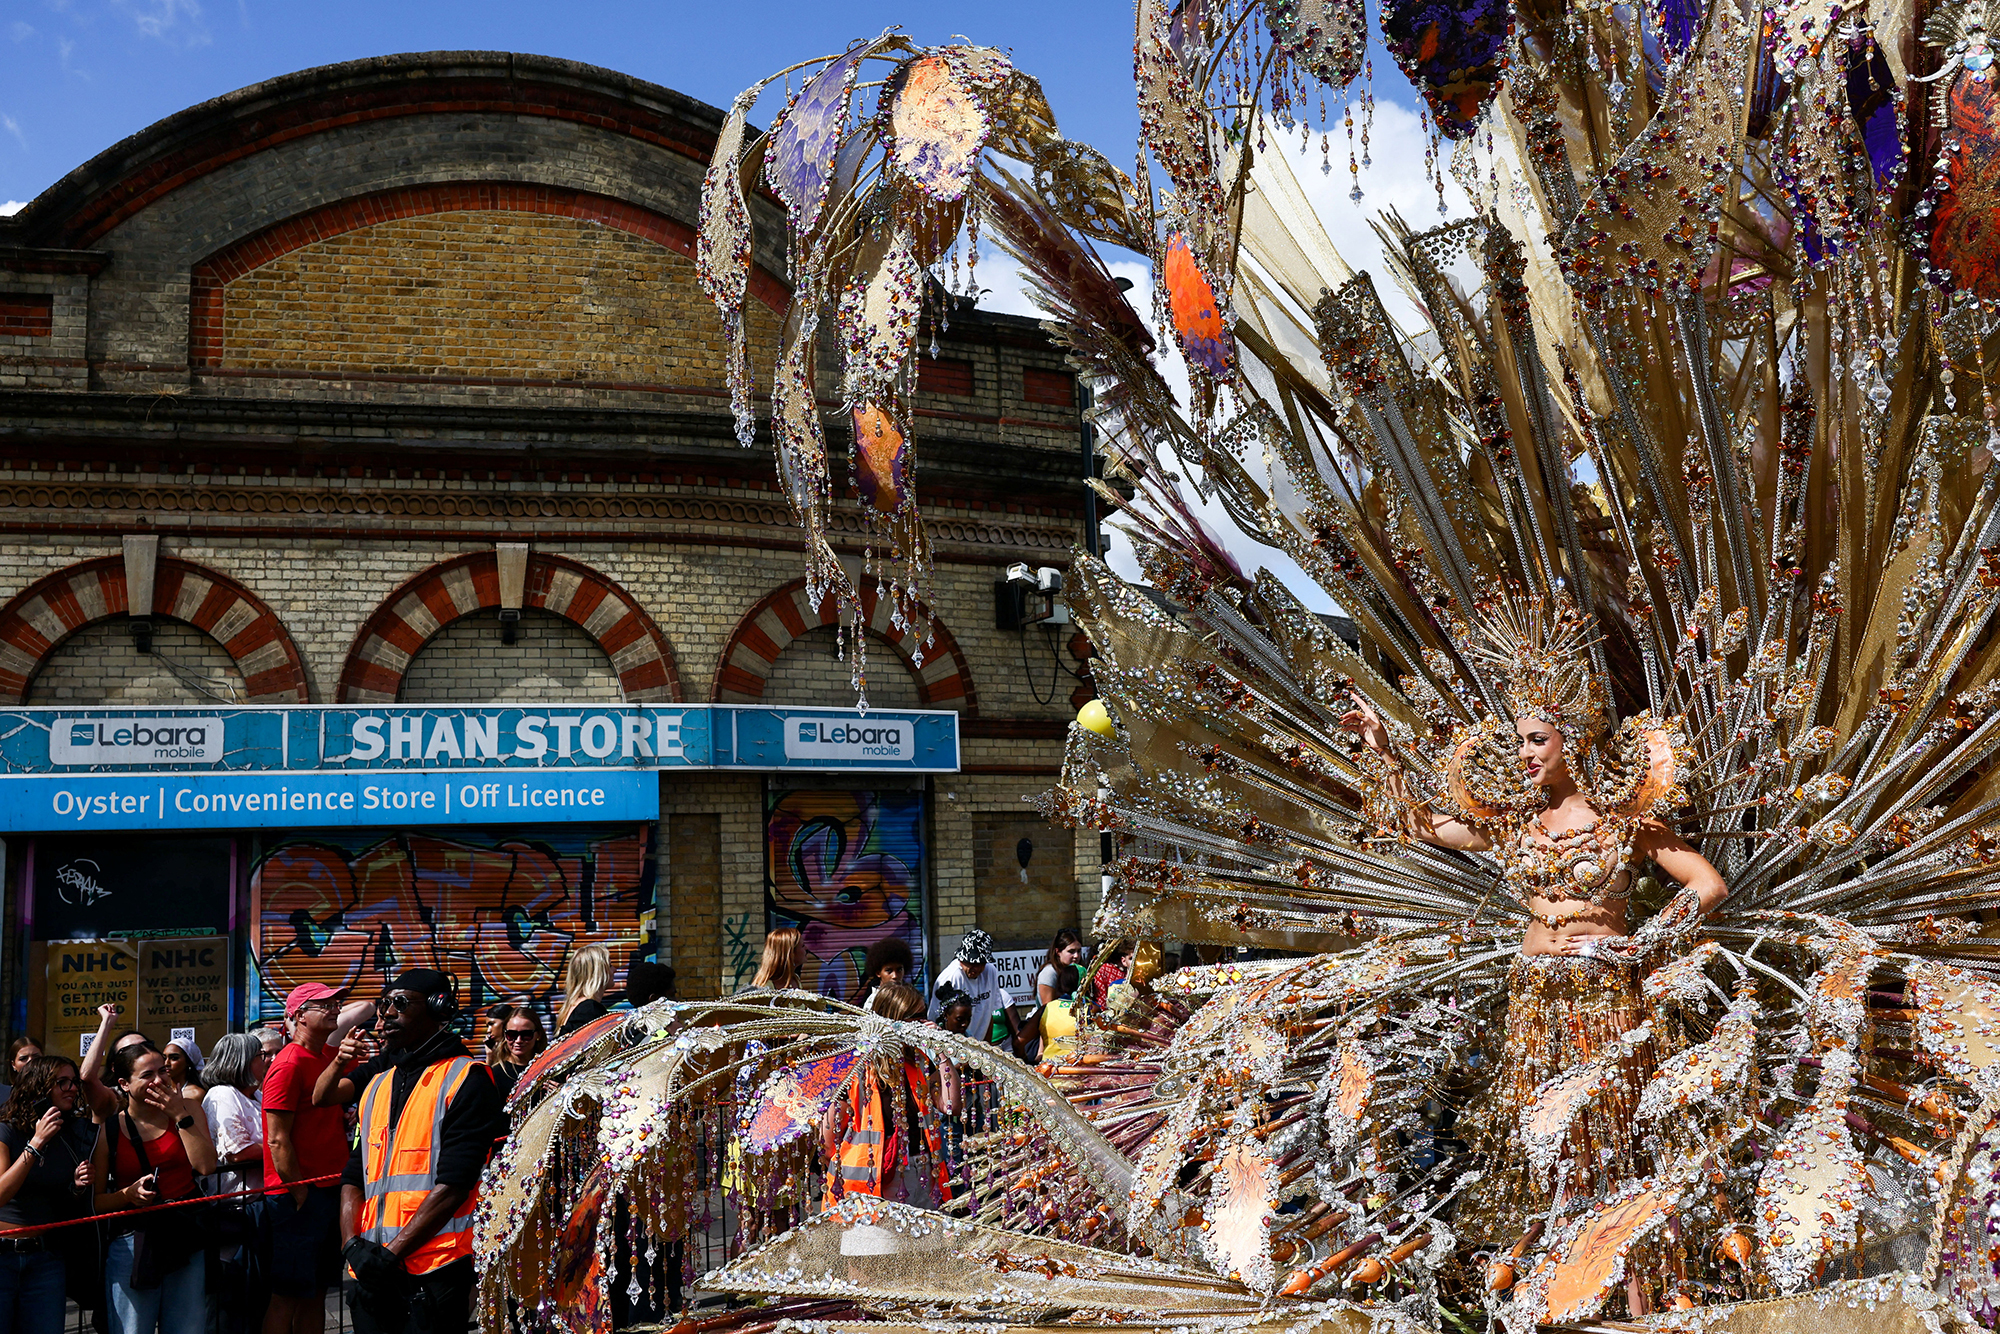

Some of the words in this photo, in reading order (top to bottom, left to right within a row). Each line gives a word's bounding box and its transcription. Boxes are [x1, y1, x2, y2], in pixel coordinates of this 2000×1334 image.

[98, 723, 206, 746] Lebara
[350, 716, 499, 760] SHAN
[514, 715, 684, 759] STORE
[820, 723, 900, 744] Lebara
[154, 746, 205, 758] mobile
[862, 745, 900, 756] mobile
[53, 790, 150, 821] Oyster
[174, 786, 354, 813] Convenience
[363, 786, 436, 809] Store
[460, 783, 500, 808] Off
[508, 783, 605, 807] Licence
[62, 952, 127, 973] NHC
[151, 948, 215, 969] NHC
[994, 956, 1026, 971] REAT
[55, 982, 78, 990] YOU
[83, 981, 103, 989] ARE
[107, 980, 134, 988] JUST
[145, 977, 169, 988] WE
[175, 975, 221, 986] KNOW
[998, 974, 1021, 988] OAD
[61, 991, 128, 1004] GETTING
[155, 994, 174, 1004] TO
[180, 992, 211, 1003] OUR
[63, 1005, 125, 1017] STARD
[147, 1004, 218, 1016] WELL-BEING
